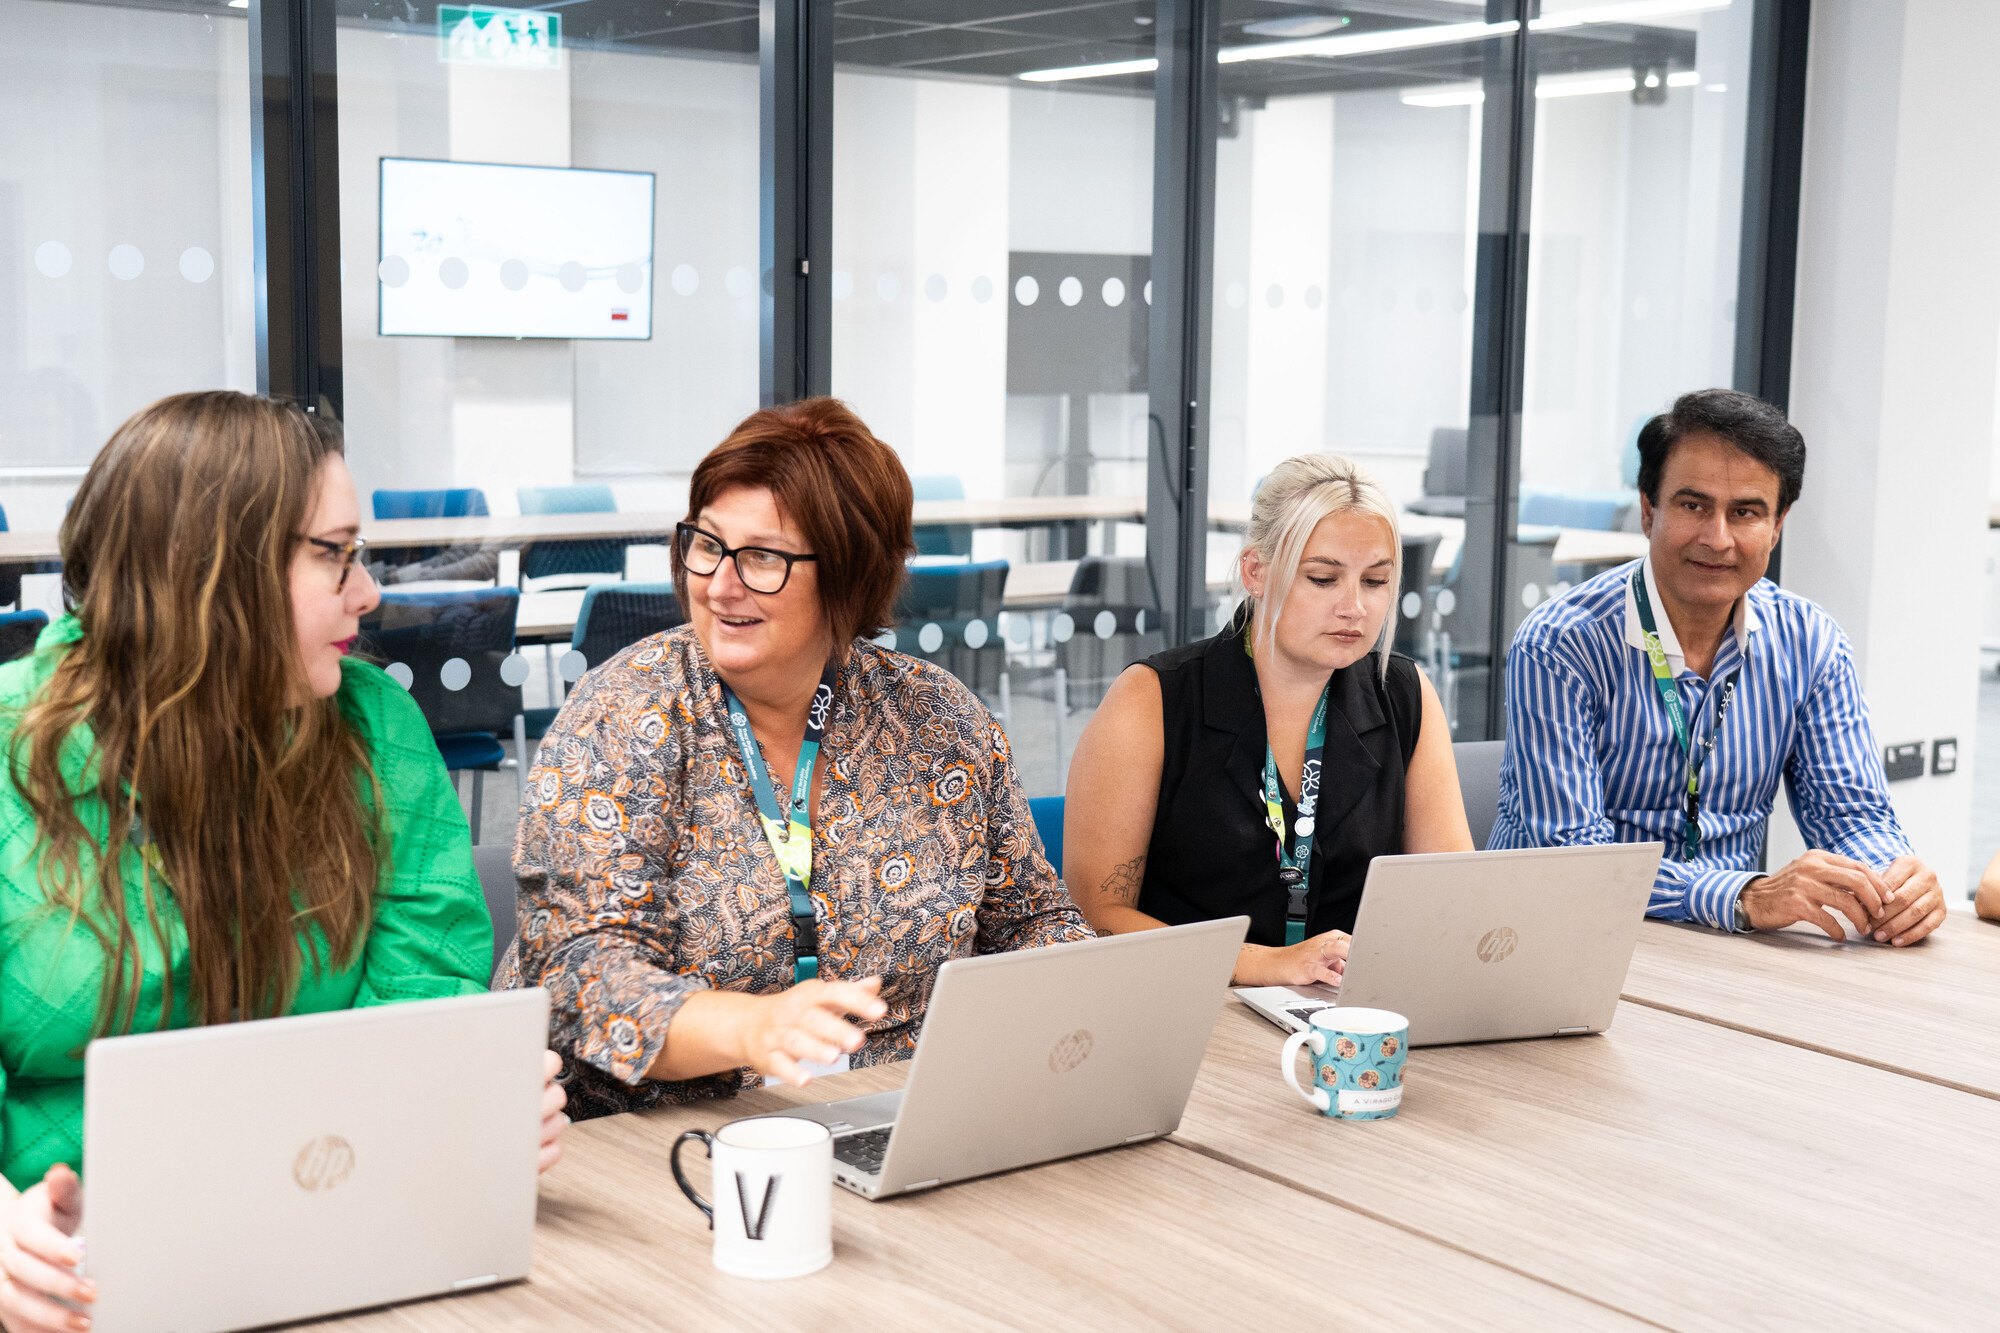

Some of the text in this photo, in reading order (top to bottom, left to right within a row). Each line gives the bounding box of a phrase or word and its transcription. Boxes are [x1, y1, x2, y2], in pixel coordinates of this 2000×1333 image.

[1477, 927, 1518, 963] hp
[292, 1135, 355, 1192] hp
[735, 1171, 783, 1240] V
